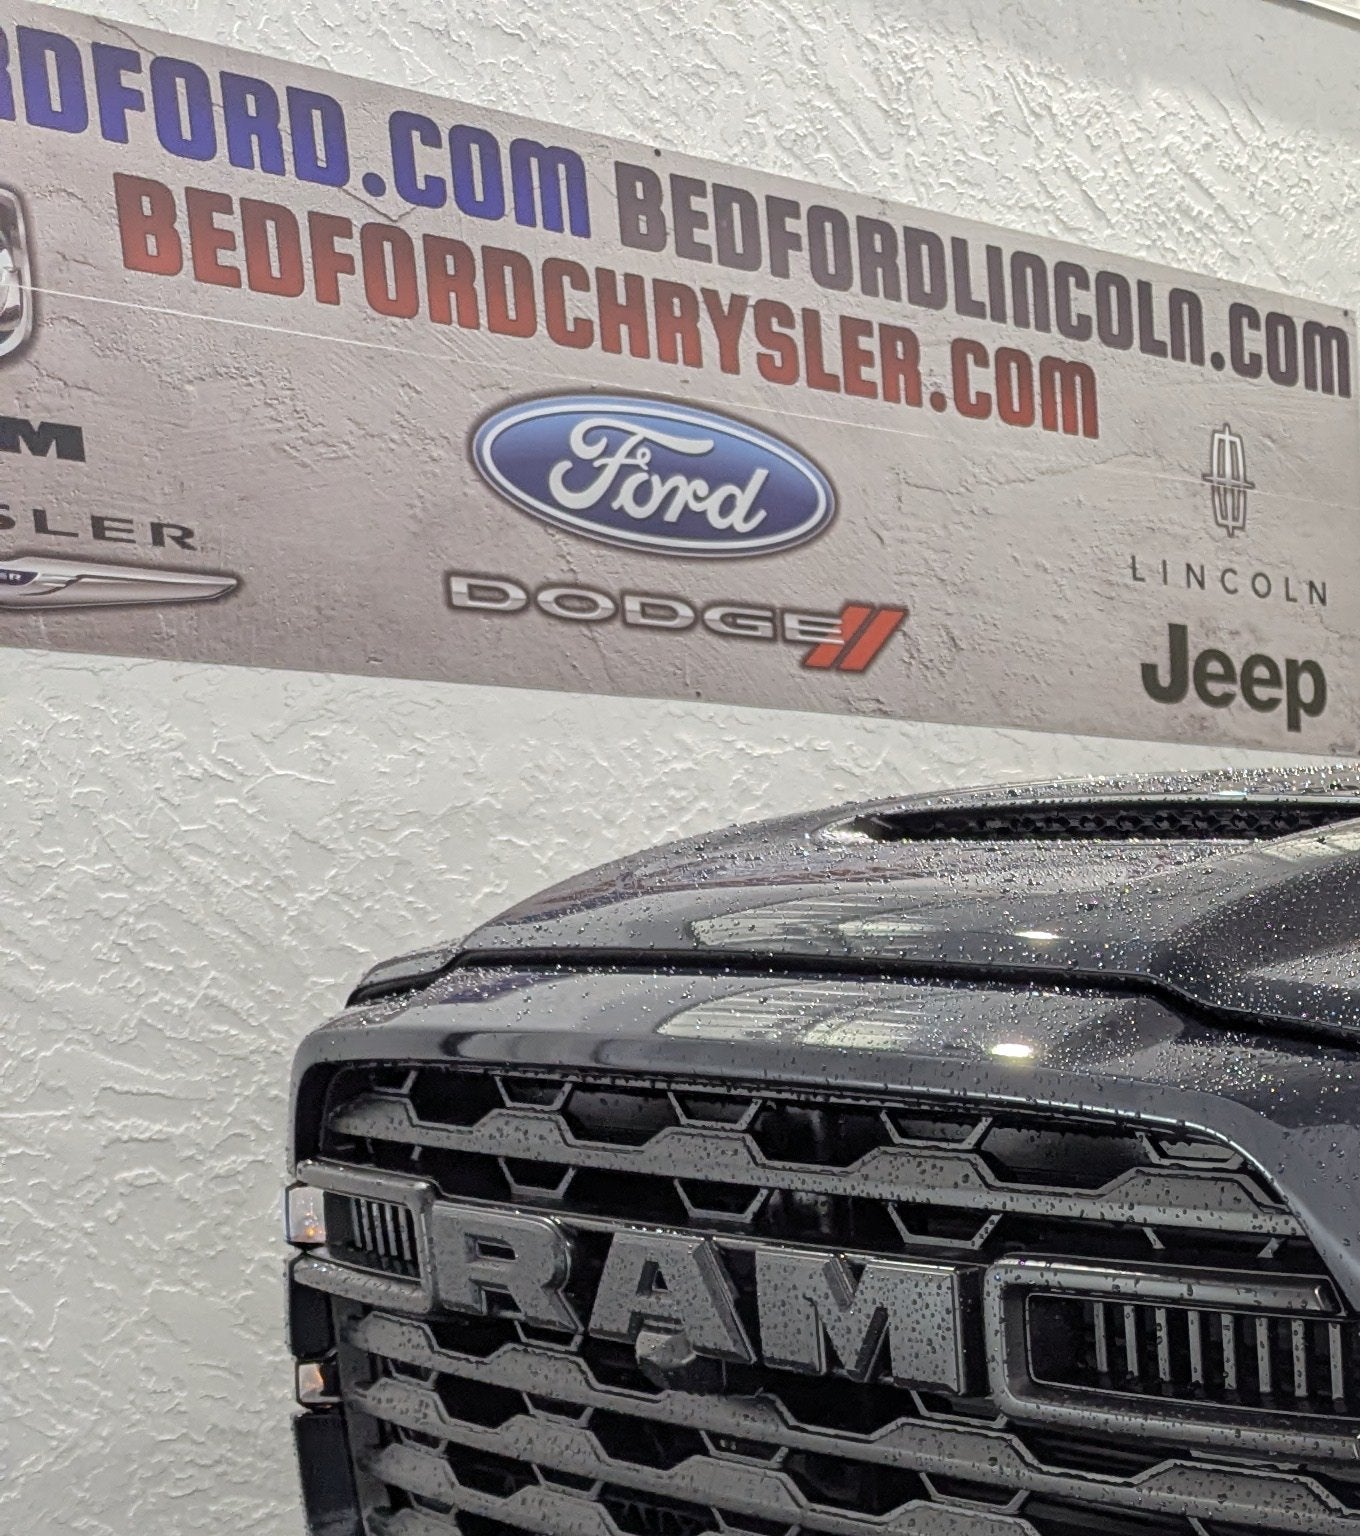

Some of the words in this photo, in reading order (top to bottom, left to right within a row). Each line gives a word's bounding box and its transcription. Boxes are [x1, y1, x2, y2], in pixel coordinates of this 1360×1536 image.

[0, 25, 591, 239] DFORD.COM
[615, 161, 1351, 399] BEDFORDLINCOLN.COM
[114, 172, 1099, 439] BEDFORDCHRYSLER.COM
[549, 417, 768, 534] Ford
[448, 575, 846, 646] DODGE
[1131, 556, 1328, 605] LINCOLN
[1141, 623, 1326, 732] Jeep
[432, 1201, 968, 1396] RAM
